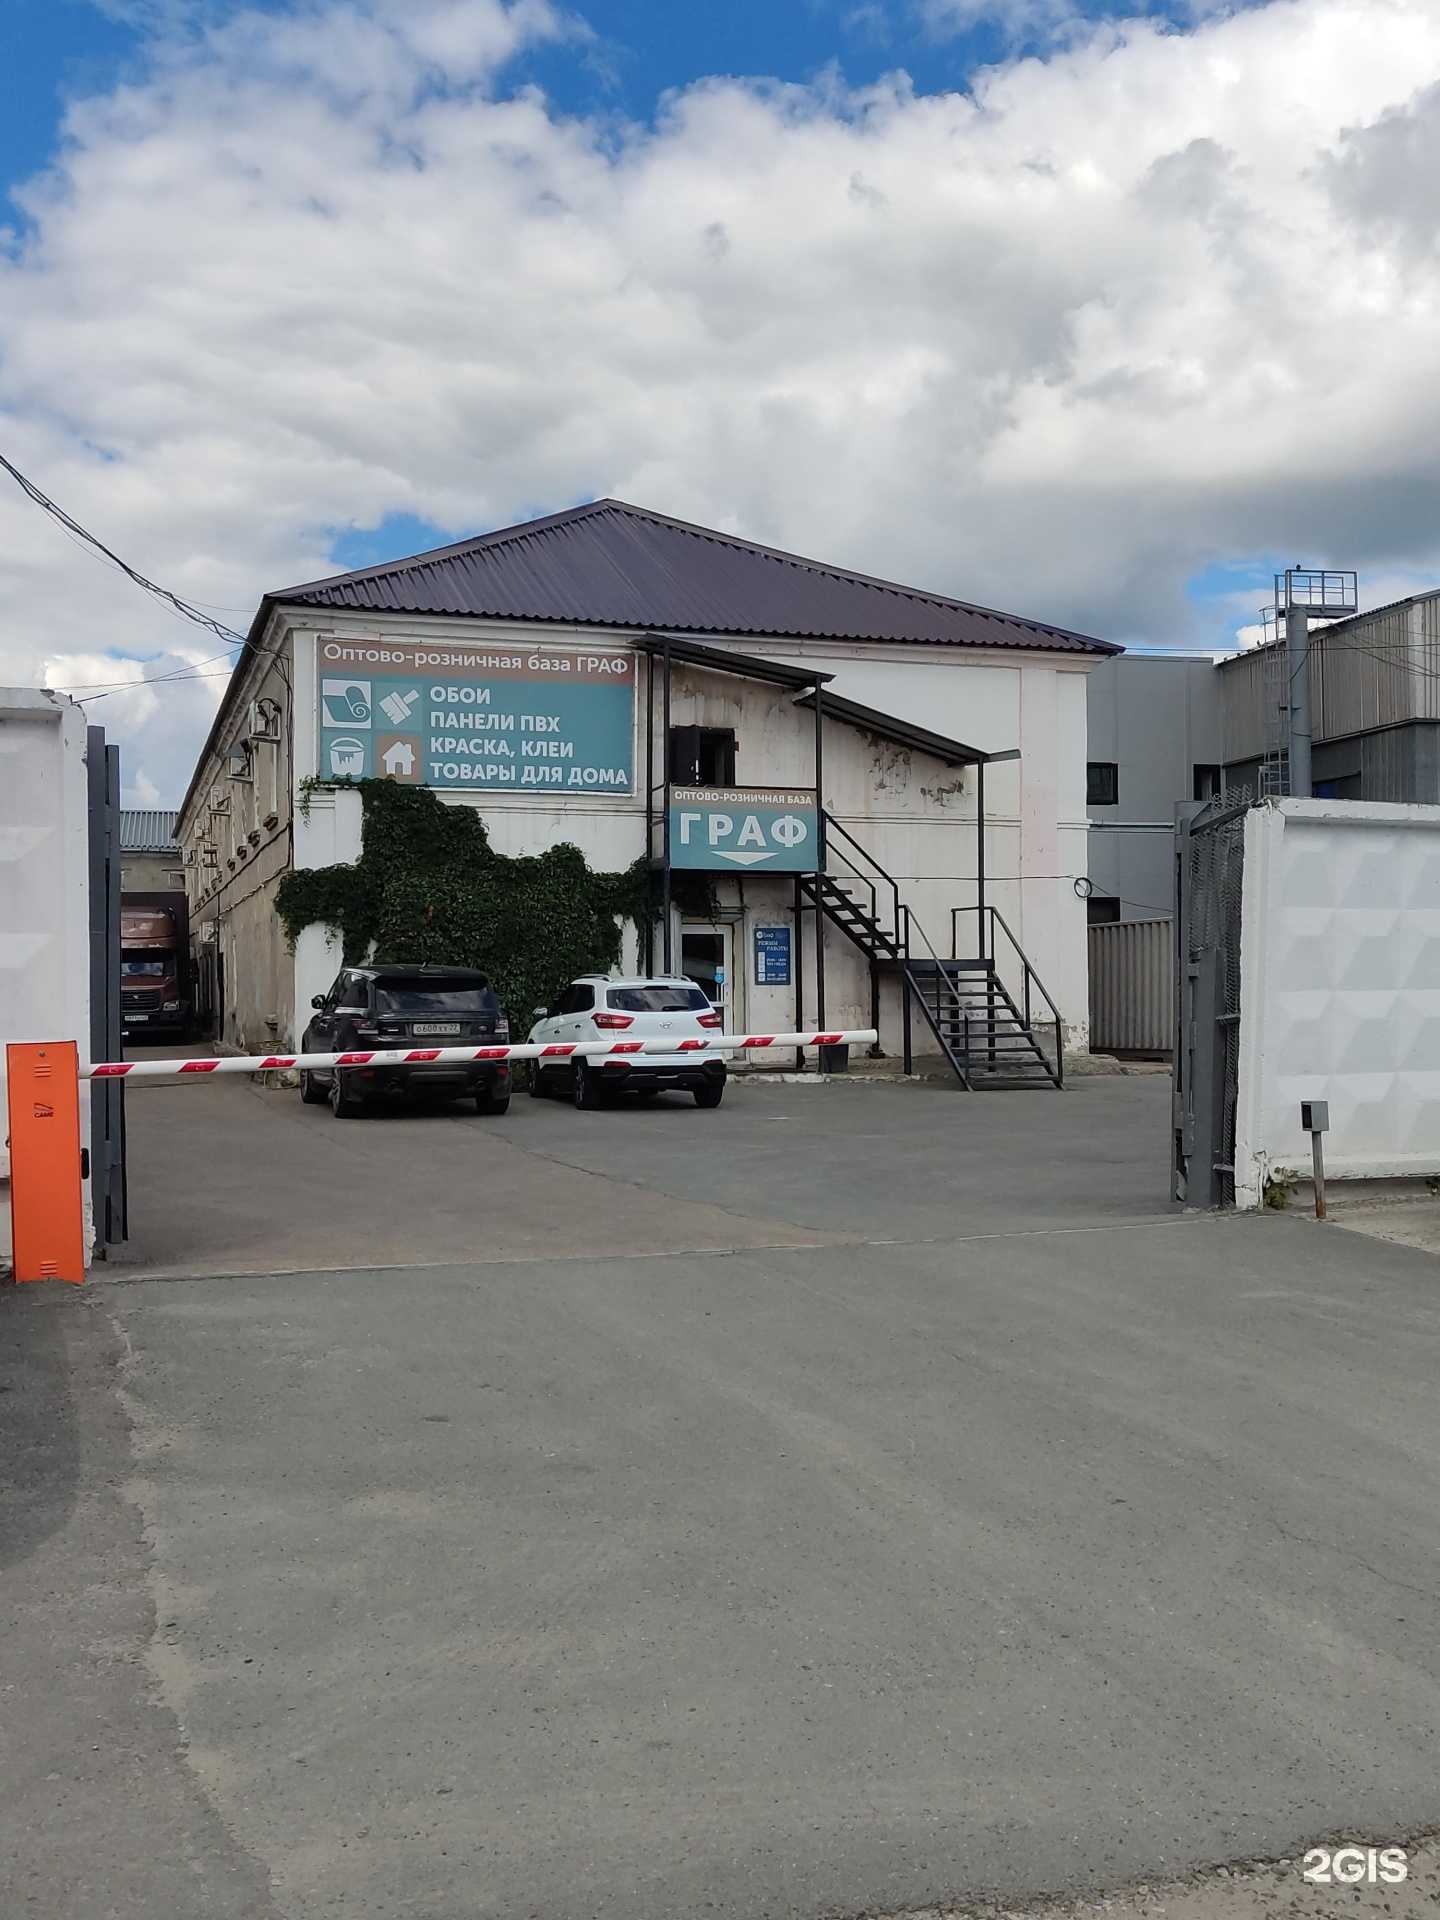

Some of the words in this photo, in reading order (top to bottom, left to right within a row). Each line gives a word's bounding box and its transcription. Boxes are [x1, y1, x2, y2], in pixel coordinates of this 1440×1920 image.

[323, 643, 522, 670] Оптово-розничная
[527, 653, 571, 672] база
[577, 656, 628, 674] ГРАФ
[430, 686, 491, 705] ОБОИ
[430, 711, 514, 731] ПАНЕЛИ
[521, 715, 561, 733] ПВХ
[430, 737, 515, 758] КРАСКА,
[521, 740, 573, 758] КЛЕИ
[430, 762, 515, 781] ТОВАРЫ
[521, 765, 563, 784] ДЛЯ
[567, 766, 628, 785] ДОМА
[674, 791, 785, 804] ОПТОВО-РОЗНИЧНАЯ
[787, 795, 812, 805] БАЗА
[680, 812, 807, 848] ГРАФ
